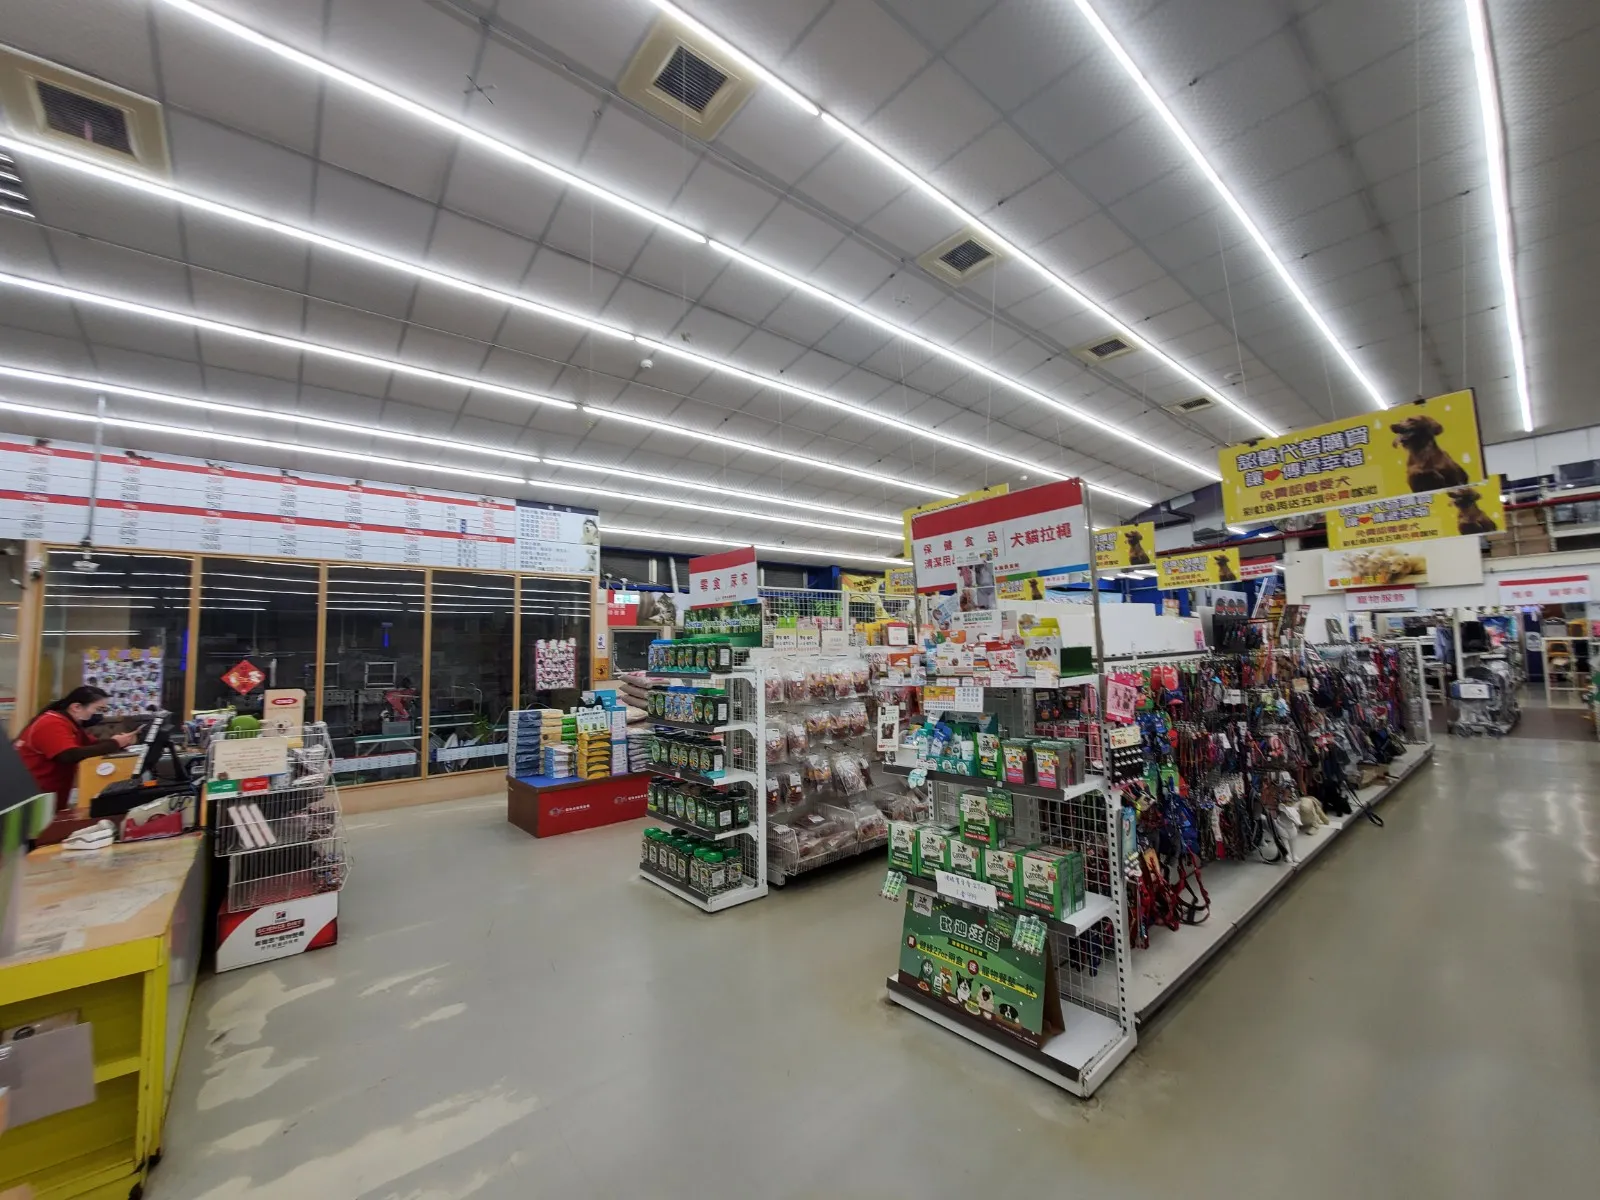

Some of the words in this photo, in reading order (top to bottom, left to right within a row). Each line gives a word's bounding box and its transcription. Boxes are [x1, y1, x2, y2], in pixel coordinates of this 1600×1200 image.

[1236, 426, 1369, 472] 認養代替購買
[1281, 447, 1365, 480] 傳遞幸福
[923, 531, 997, 555] 保健食品
[1010, 522, 1072, 548] 犬貓拉繩
[924, 553, 956, 569] 清潔用
